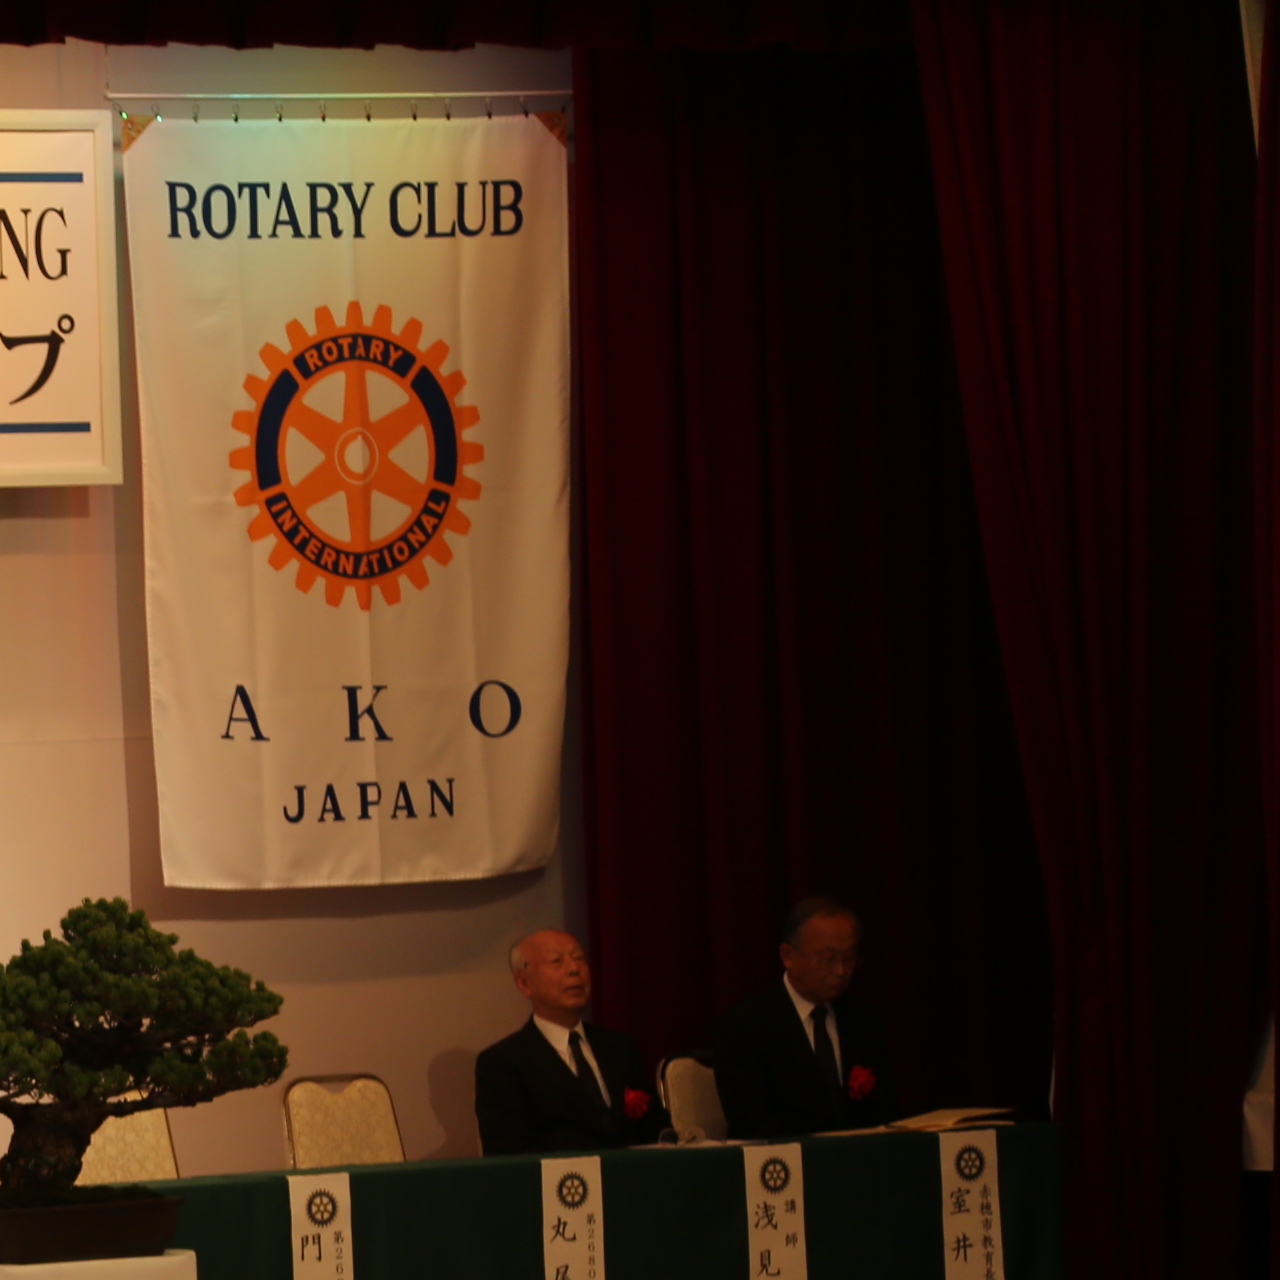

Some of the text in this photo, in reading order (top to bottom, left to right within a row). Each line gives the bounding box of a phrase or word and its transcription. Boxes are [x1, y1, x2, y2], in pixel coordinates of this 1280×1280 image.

[165, 178, 524, 240] ROTARY CLUB
[304, 335, 405, 372] ROTARY
[270, 495, 451, 577] INTERNATIONAL
[282, 778, 457, 825] JAPAN
